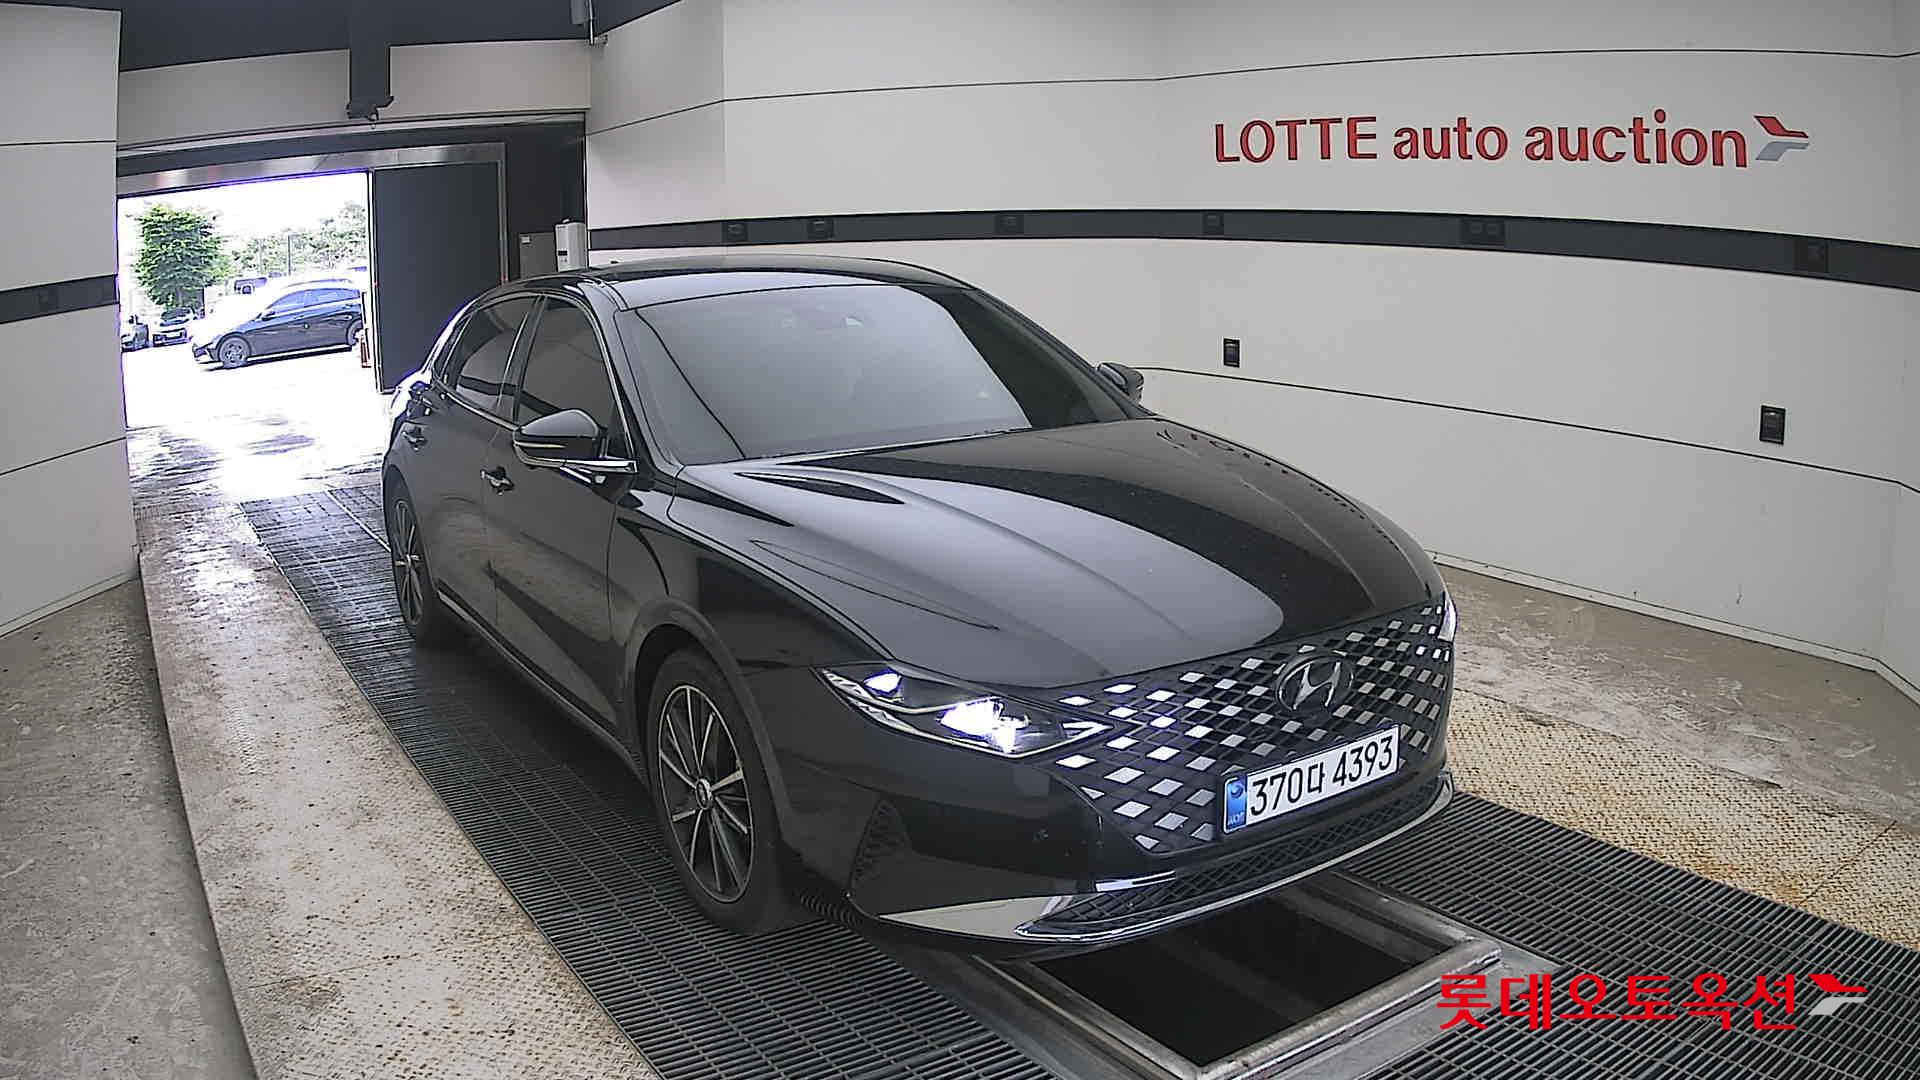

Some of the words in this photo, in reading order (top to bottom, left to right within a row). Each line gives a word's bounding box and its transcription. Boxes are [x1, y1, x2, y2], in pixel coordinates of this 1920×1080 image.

[1215, 115, 1378, 162] LOTTE
[1392, 116, 1509, 161] auto
[1524, 109, 1748, 168] auction
[1250, 761, 1326, 816] 370다
[1332, 735, 1393, 786] 4393
